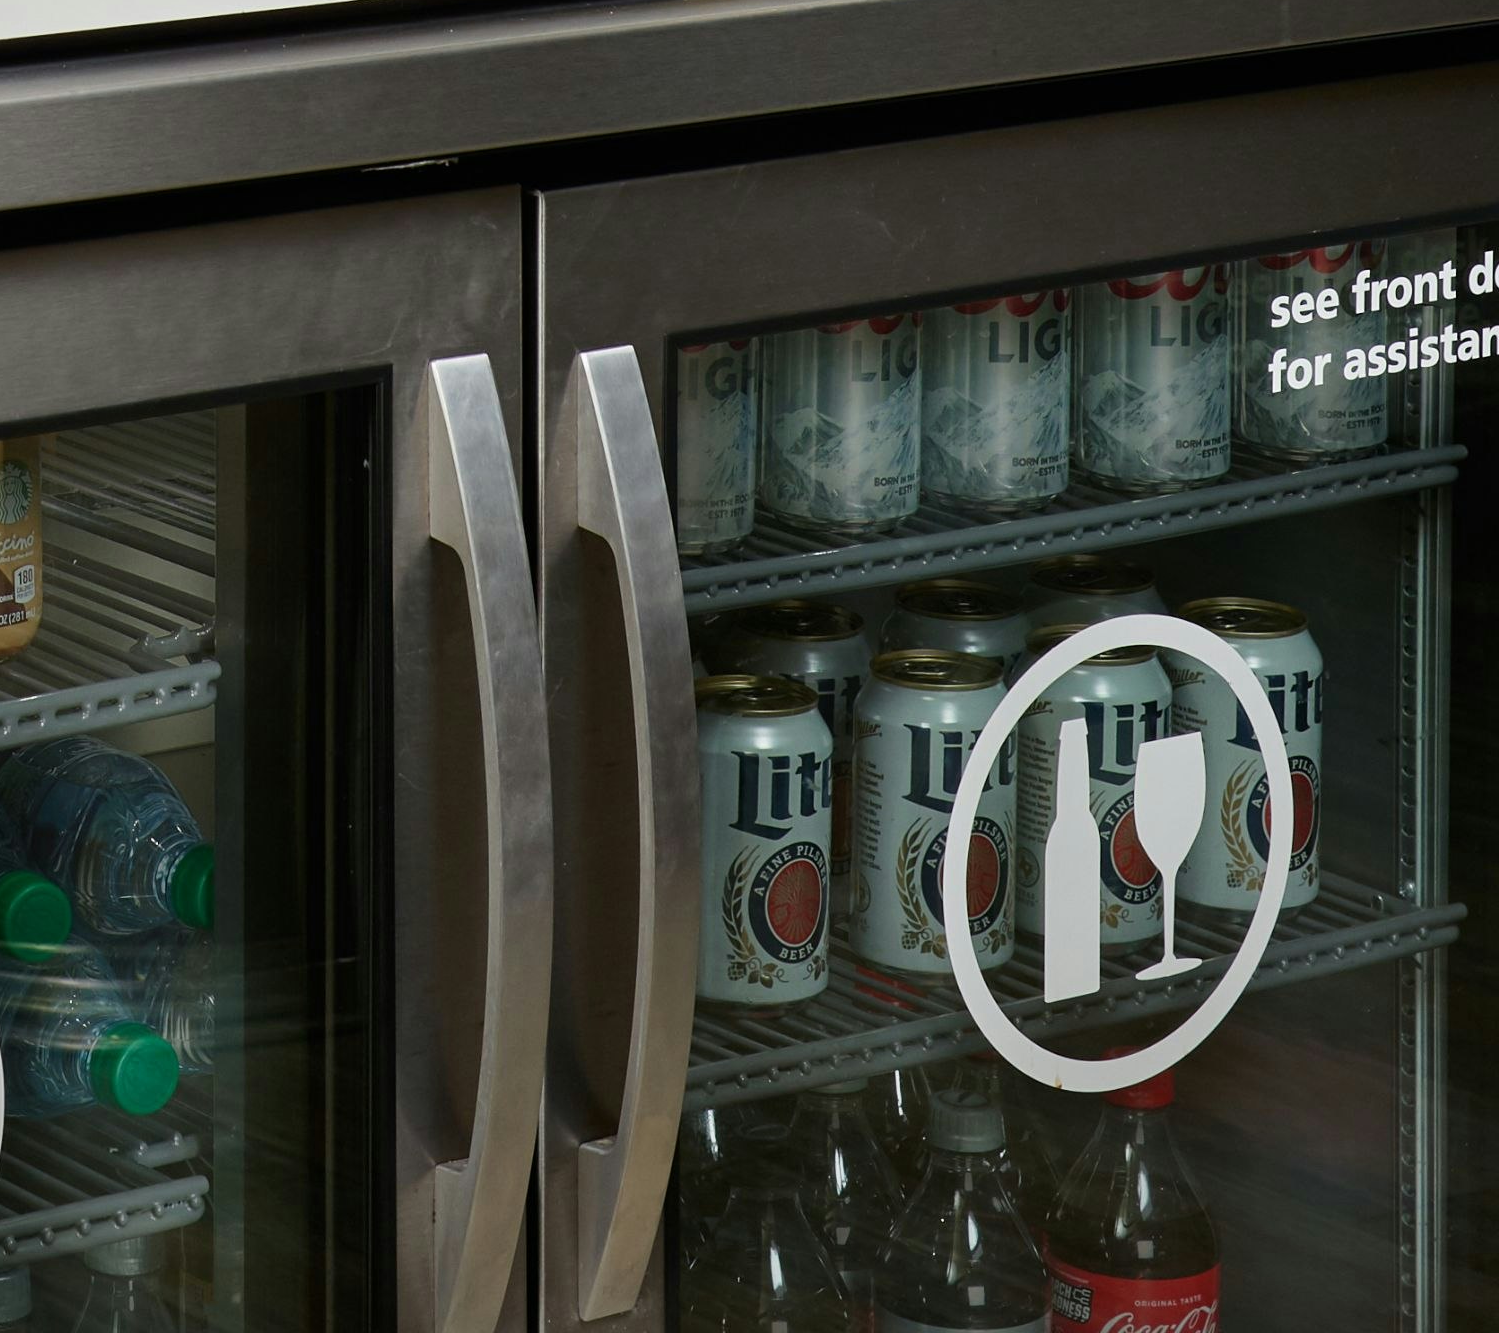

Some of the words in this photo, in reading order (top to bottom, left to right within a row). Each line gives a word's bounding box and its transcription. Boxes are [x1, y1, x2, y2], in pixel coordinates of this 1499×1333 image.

[1270, 287, 1339, 328] see
[1352, 260, 1457, 314] front
[1268, 348, 1331, 394] for
[1175, 436, 1202, 450] BORN
[1012, 455, 1039, 467] BORN
[875, 476, 899, 487] BORN
[18, 568, 34, 586] 180
[729, 751, 832, 841] Lite
[1180, 1294, 1202, 1305] TASTE
